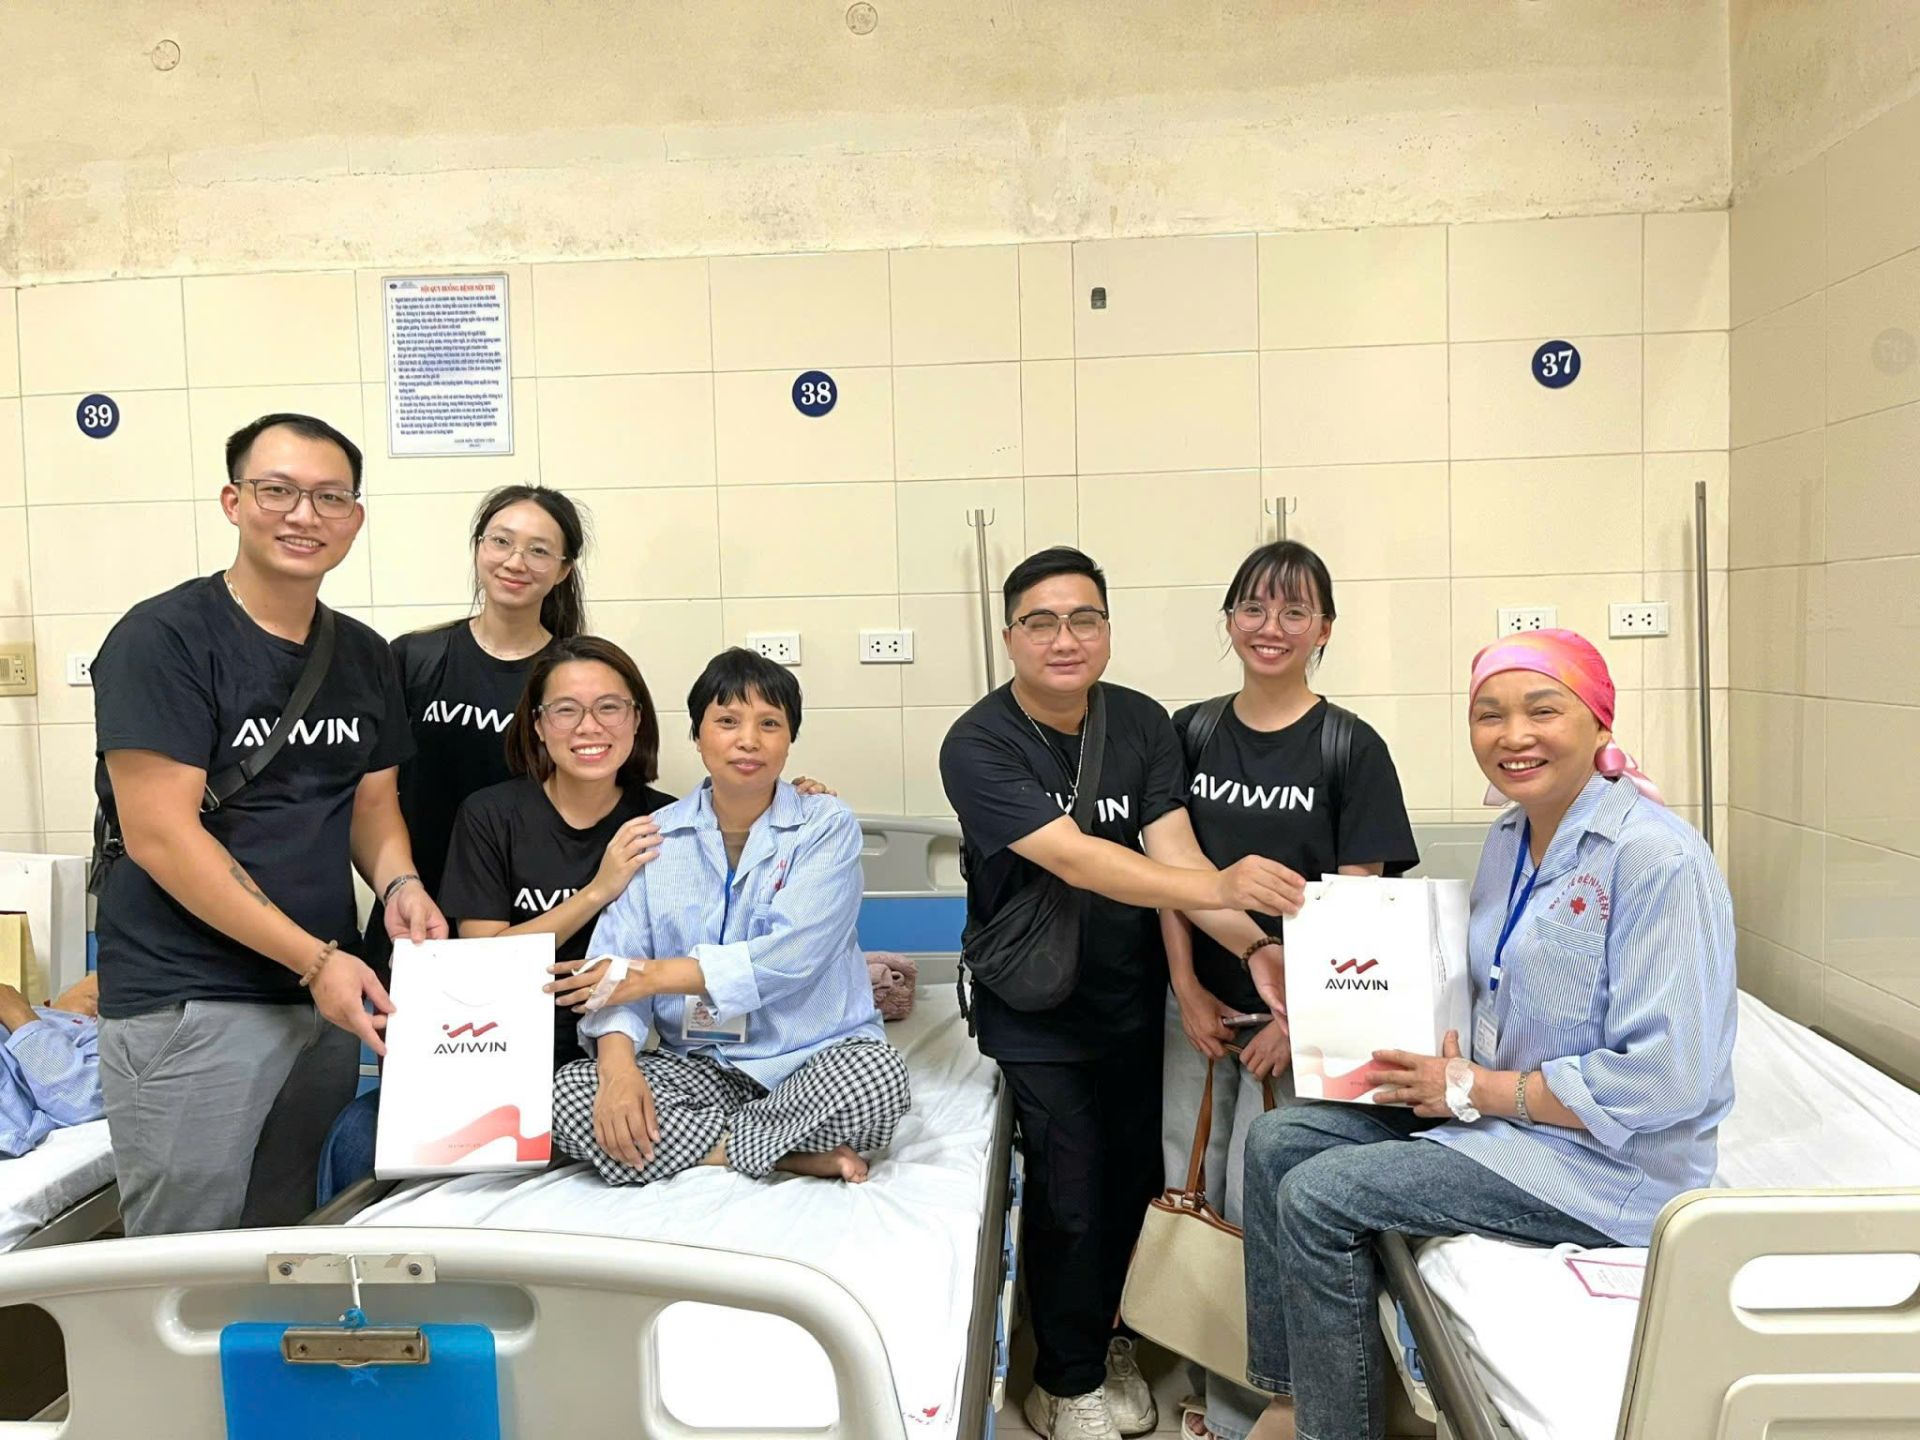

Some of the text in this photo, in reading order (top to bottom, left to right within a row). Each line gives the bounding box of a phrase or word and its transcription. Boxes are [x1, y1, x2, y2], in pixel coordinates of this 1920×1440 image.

[1541, 349, 1573, 378] 37
[801, 381, 832, 405] 38
[84, 404, 113, 428] 39
[422, 700, 515, 733] AVIW
[231, 717, 360, 747] AVWIN
[1190, 772, 1315, 812] AVIWIN
[1325, 978, 1389, 991] AVIWIN
[433, 1041, 507, 1054] AVIWIN
